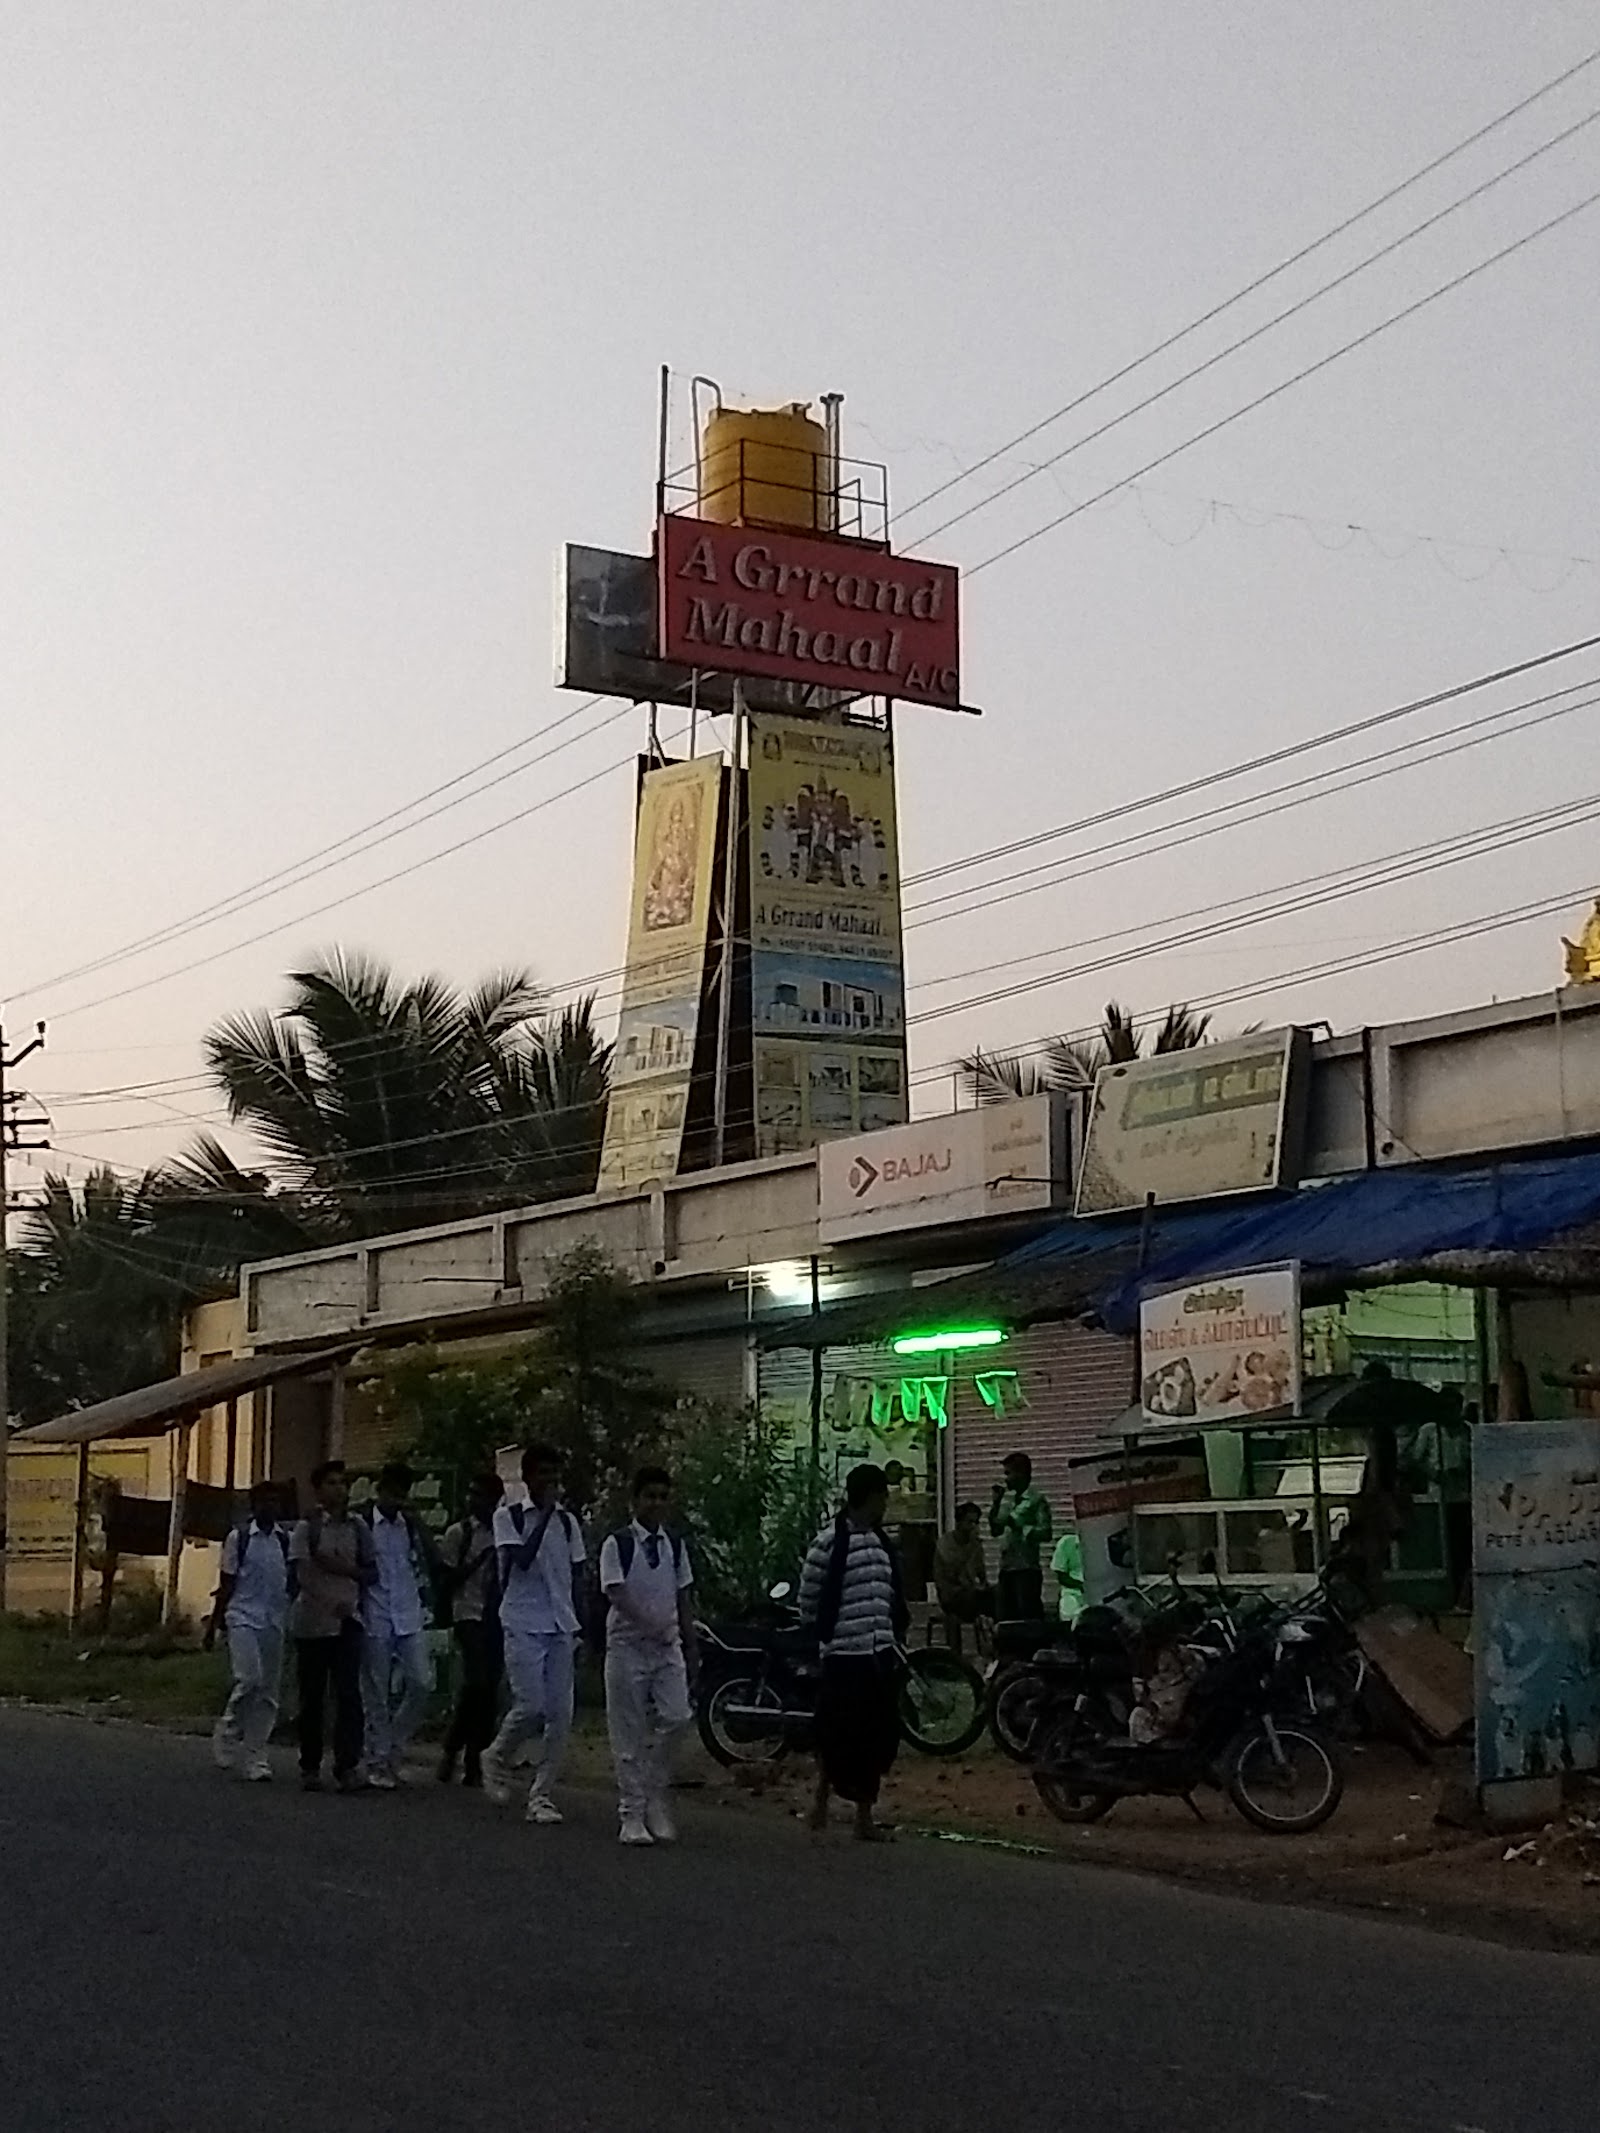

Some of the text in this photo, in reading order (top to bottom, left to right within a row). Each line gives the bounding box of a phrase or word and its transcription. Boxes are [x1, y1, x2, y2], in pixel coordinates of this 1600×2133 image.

[678, 535, 944, 622] A Grrand
[684, 597, 957, 692] Mahaal A/C
[756, 904, 766, 924] A
[771, 905, 823, 929] Grrand
[882, 1149, 952, 1182] BAJAJ
